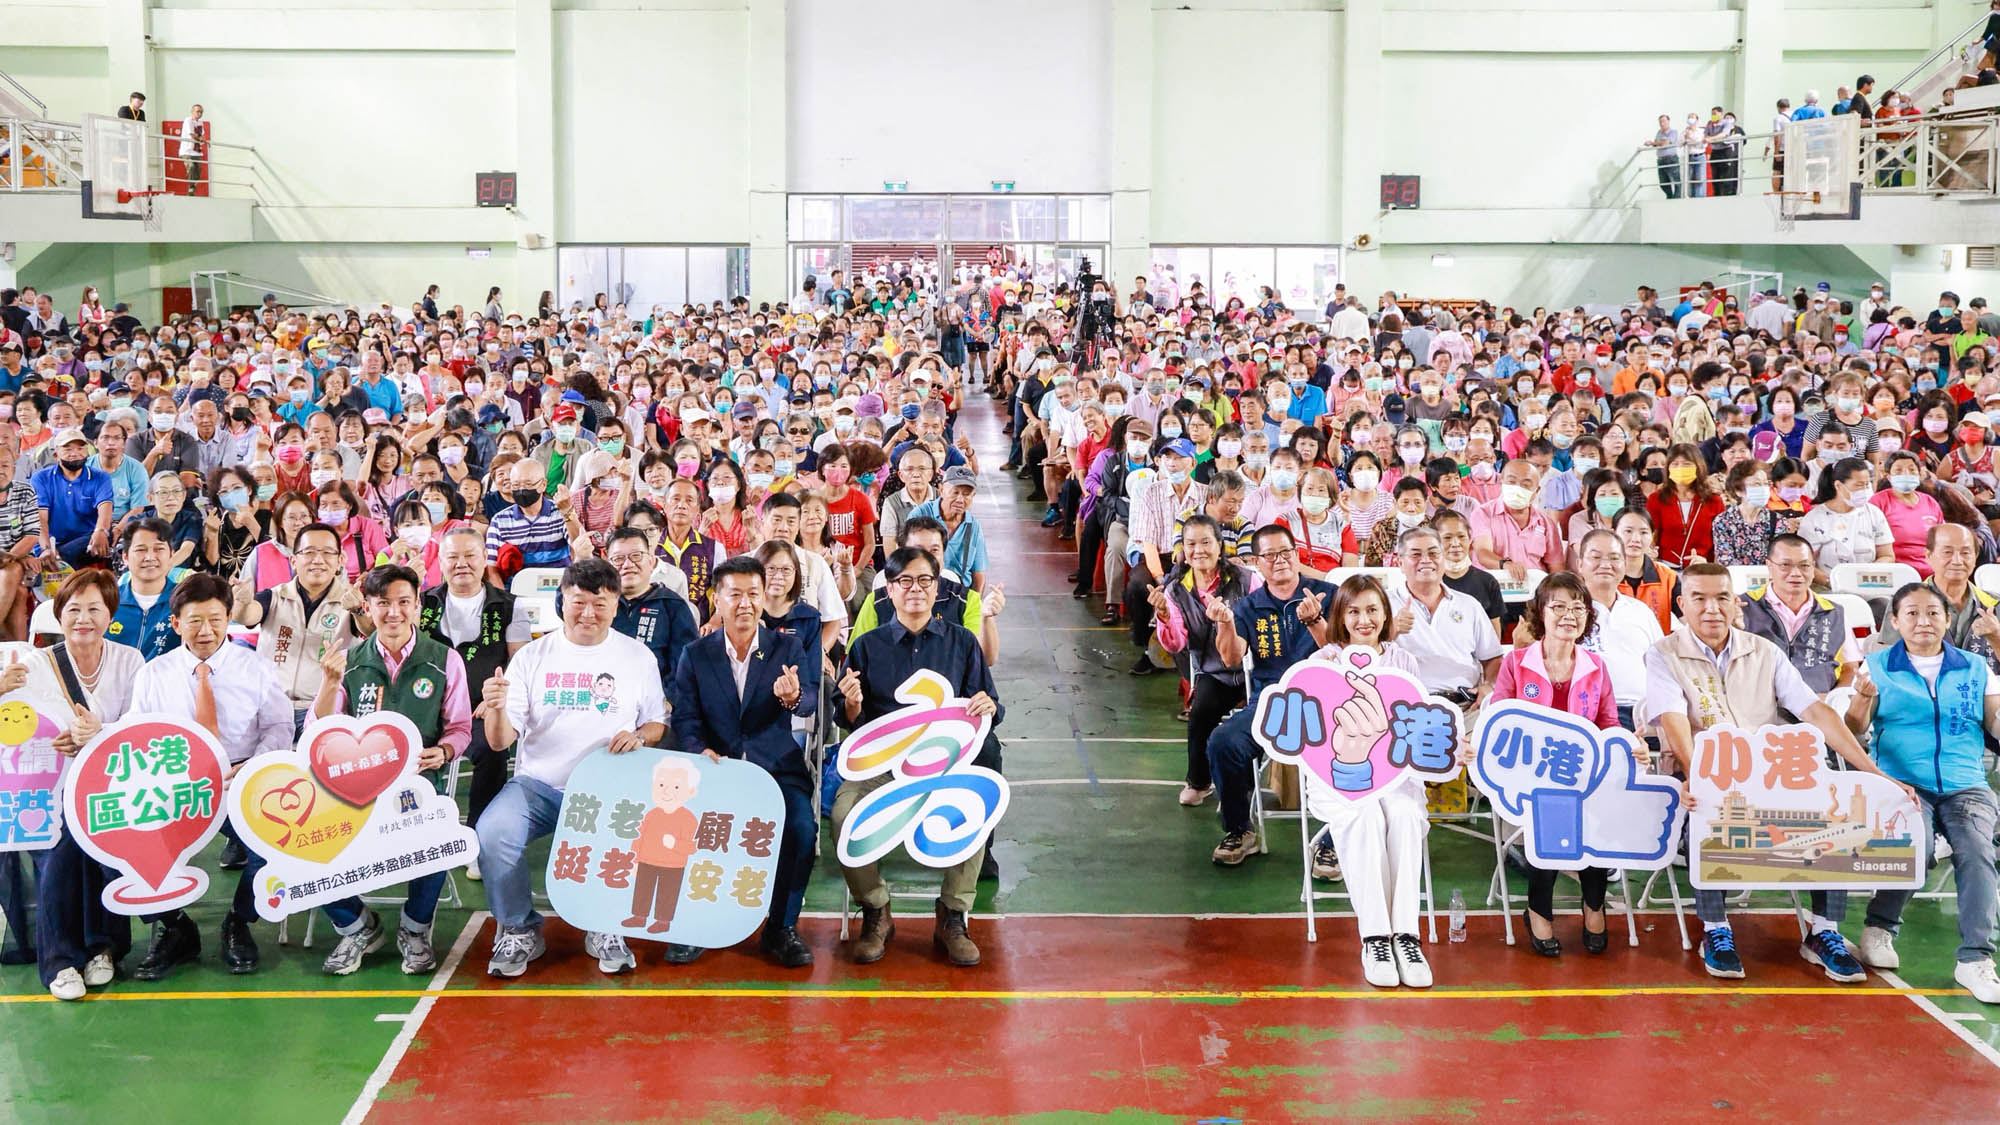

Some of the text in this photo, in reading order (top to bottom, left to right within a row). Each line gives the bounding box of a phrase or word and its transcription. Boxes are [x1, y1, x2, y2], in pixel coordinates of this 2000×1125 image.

[274, 625, 293, 665] 陳致中
[545, 672, 593, 689] 歡喜做
[105, 733, 191, 783] 小港
[1491, 727, 1585, 786] 小港
[1698, 731, 1819, 790] 小港
[88, 777, 213, 835] 區公所
[378, 808, 447, 836] 財政部關心您
[563, 792, 778, 859] 敬老 顧老
[294, 821, 354, 850] 公益彩券
[288, 839, 468, 902] 高雄市公益彩券盈餘基金補助
[553, 840, 769, 909] 挺老 安老
[1853, 861, 1908, 872] Siaogang
